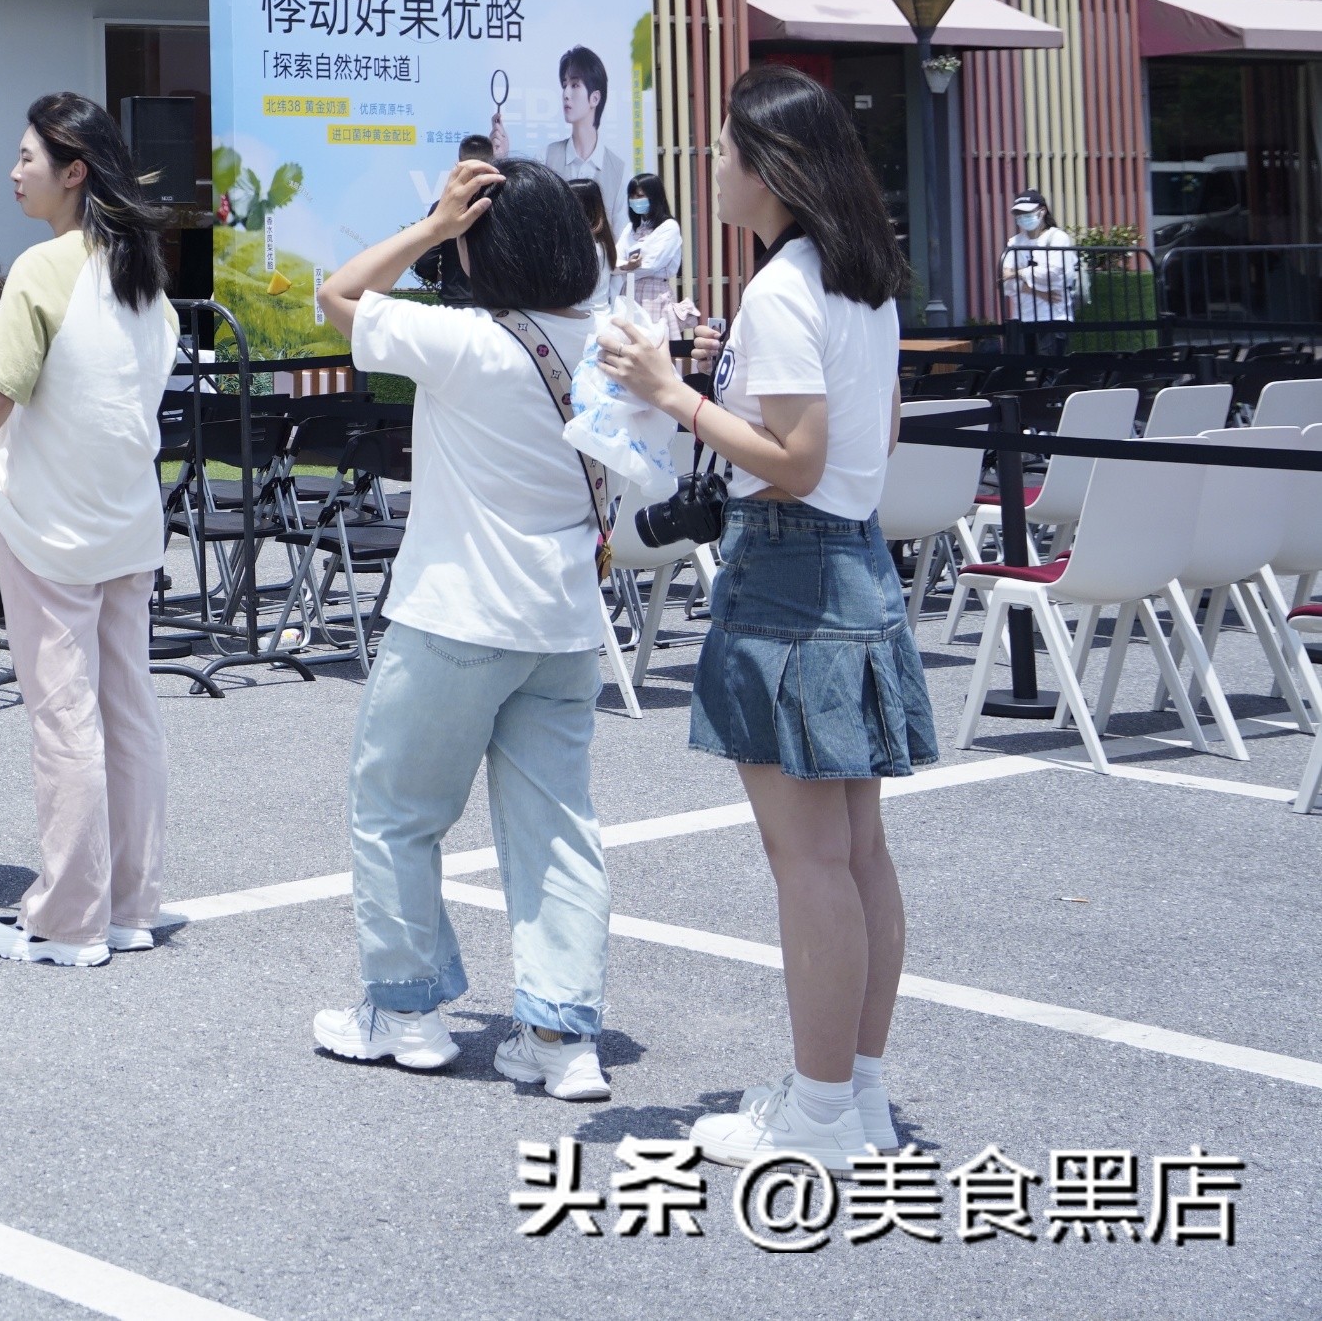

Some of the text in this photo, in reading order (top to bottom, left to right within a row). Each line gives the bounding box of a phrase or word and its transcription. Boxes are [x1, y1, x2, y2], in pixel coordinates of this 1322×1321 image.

[266, 99, 414, 115] 北纬38 黄金奶源 优质高原牛乳
[315, 268, 323, 323] 双生优酪
